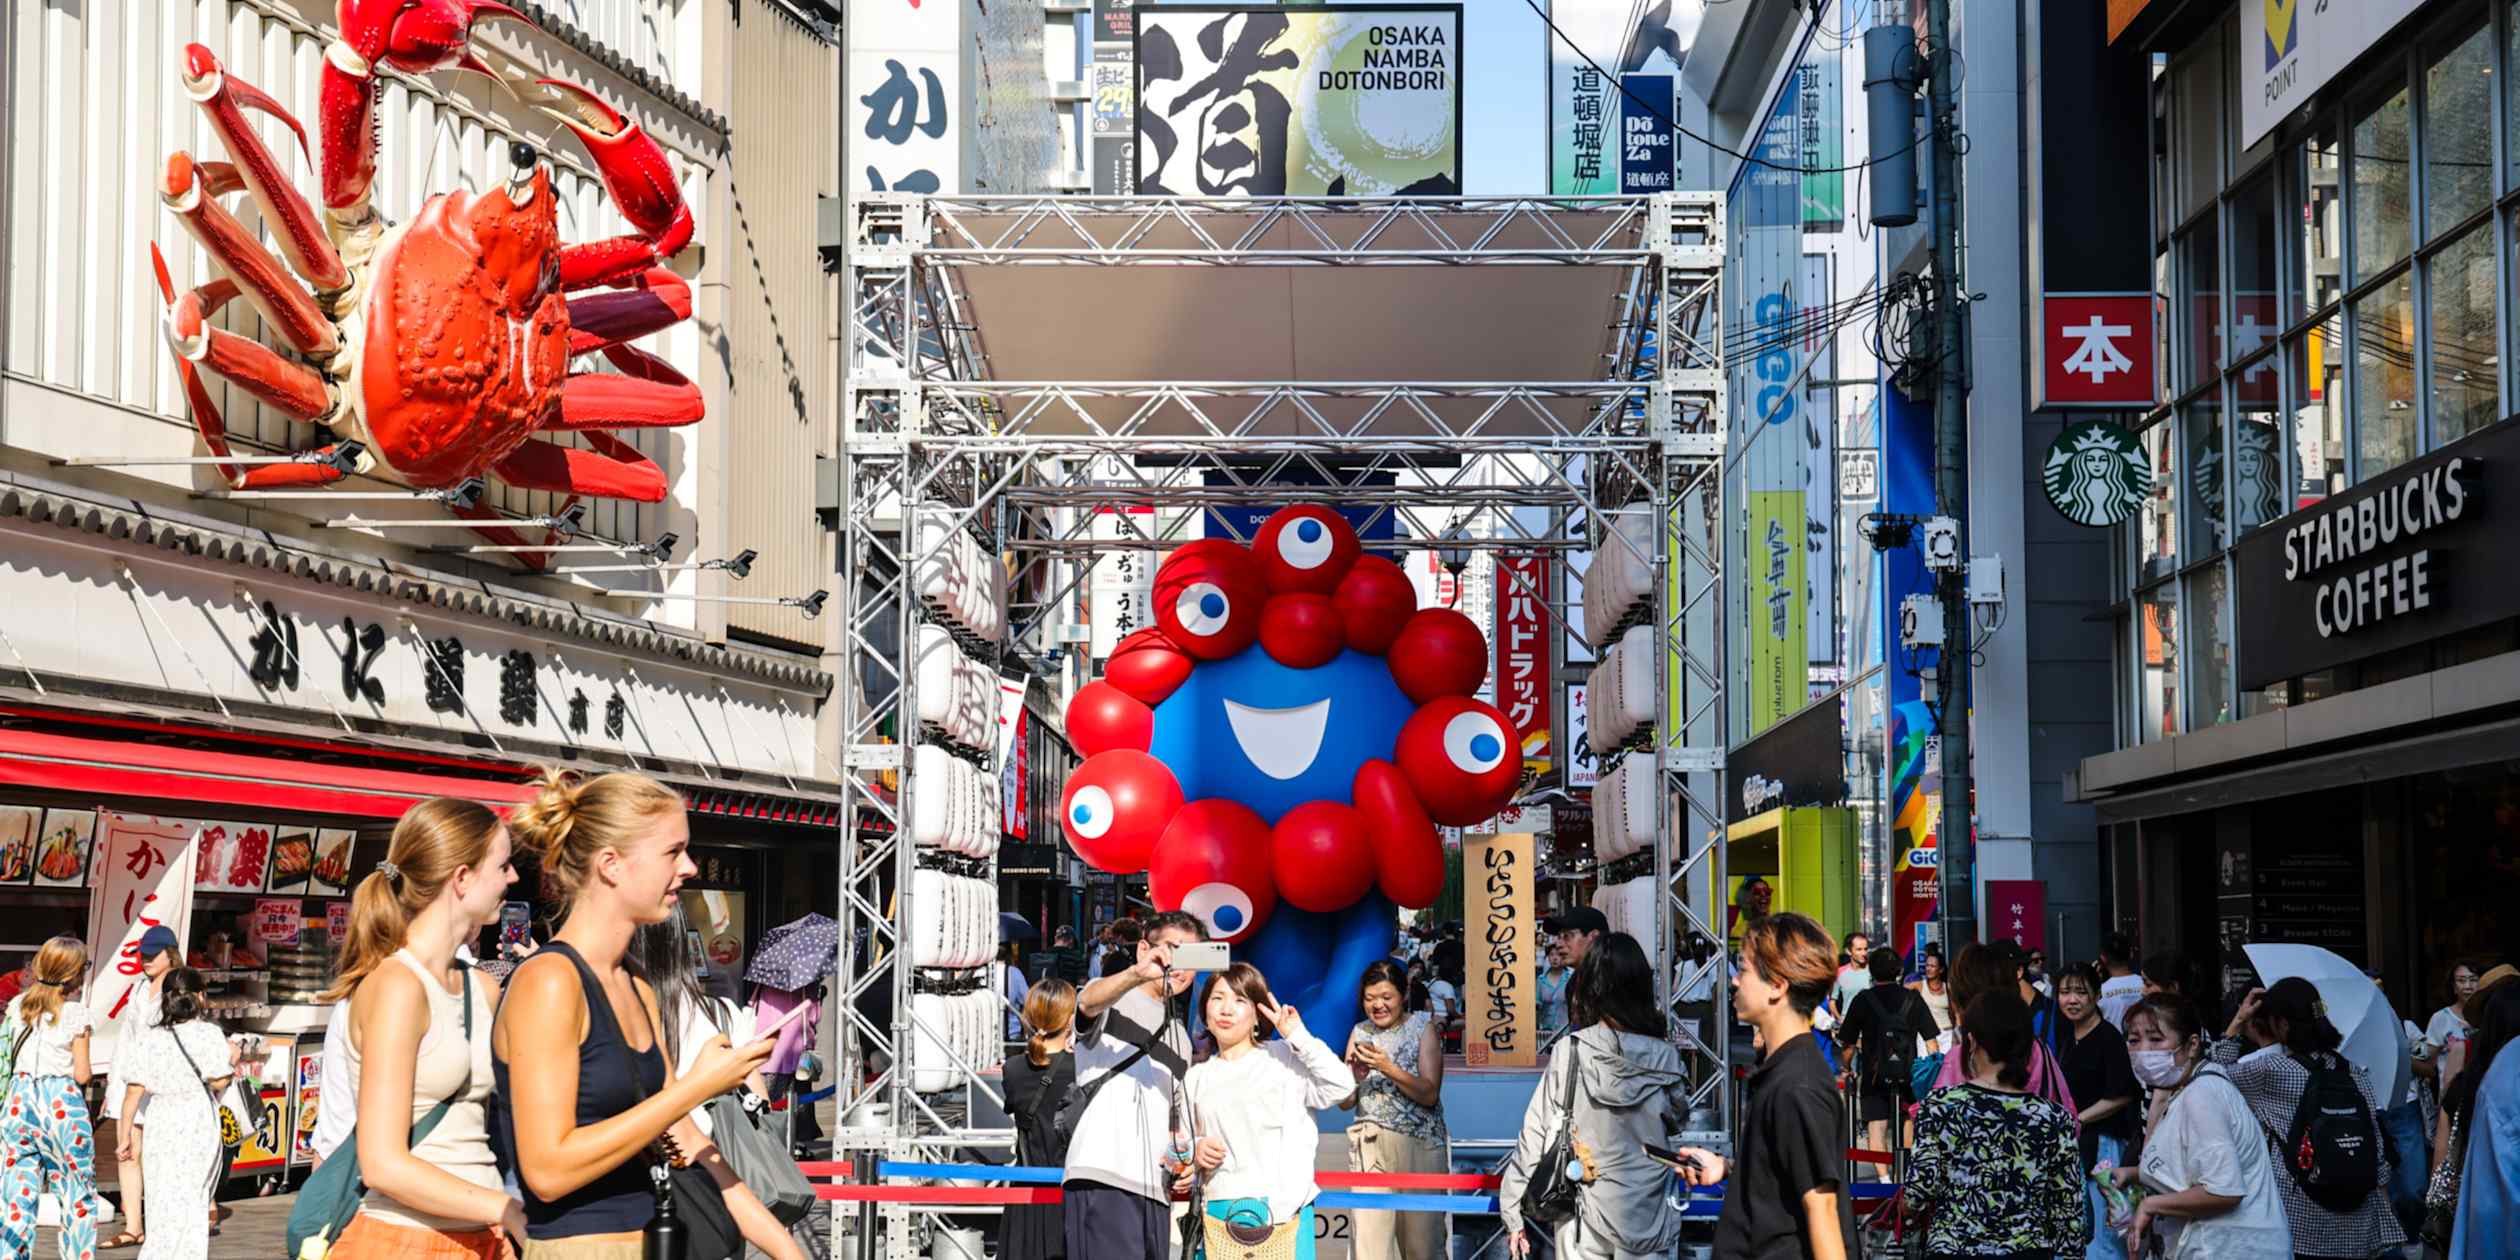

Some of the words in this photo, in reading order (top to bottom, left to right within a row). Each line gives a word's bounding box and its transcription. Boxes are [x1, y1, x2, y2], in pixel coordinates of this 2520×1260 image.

[1364, 49, 1445, 68] NAMBA
[1369, 26, 1445, 46] OSAKA
[1319, 71, 1444, 90] DOTONBORI
[2265, 57, 2298, 107] POINT
[1573, 65, 1600, 180] 道頓堀店
[1626, 146, 1651, 161] Za
[2062, 315, 2133, 384] 本
[2285, 457, 2464, 581] STARBUCKS
[1115, 516, 1137, 644] ばぢゅう本
[2315, 549, 2430, 638] COFFEE
[1484, 847, 1517, 1054] いらっしゃいませ
